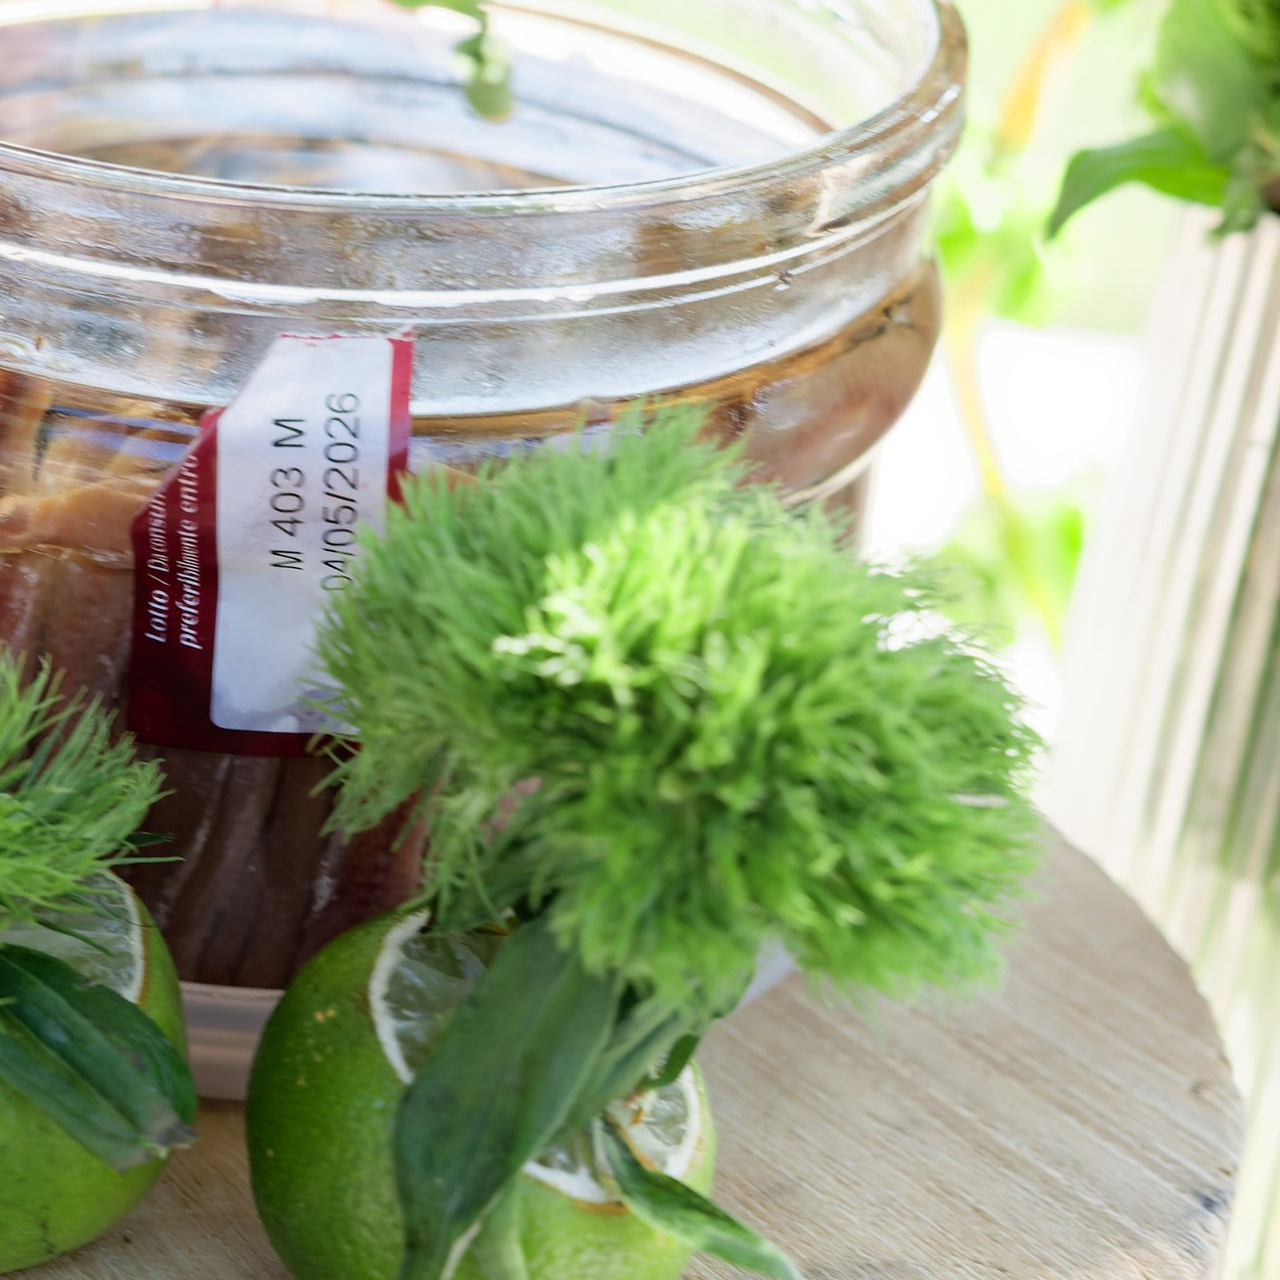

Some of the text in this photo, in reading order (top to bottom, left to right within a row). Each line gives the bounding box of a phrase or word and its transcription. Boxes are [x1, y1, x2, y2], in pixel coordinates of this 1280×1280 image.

[177, 454, 199, 513] entro
[270, 418, 306, 570] M 403 M
[145, 588, 170, 643] Lotto
